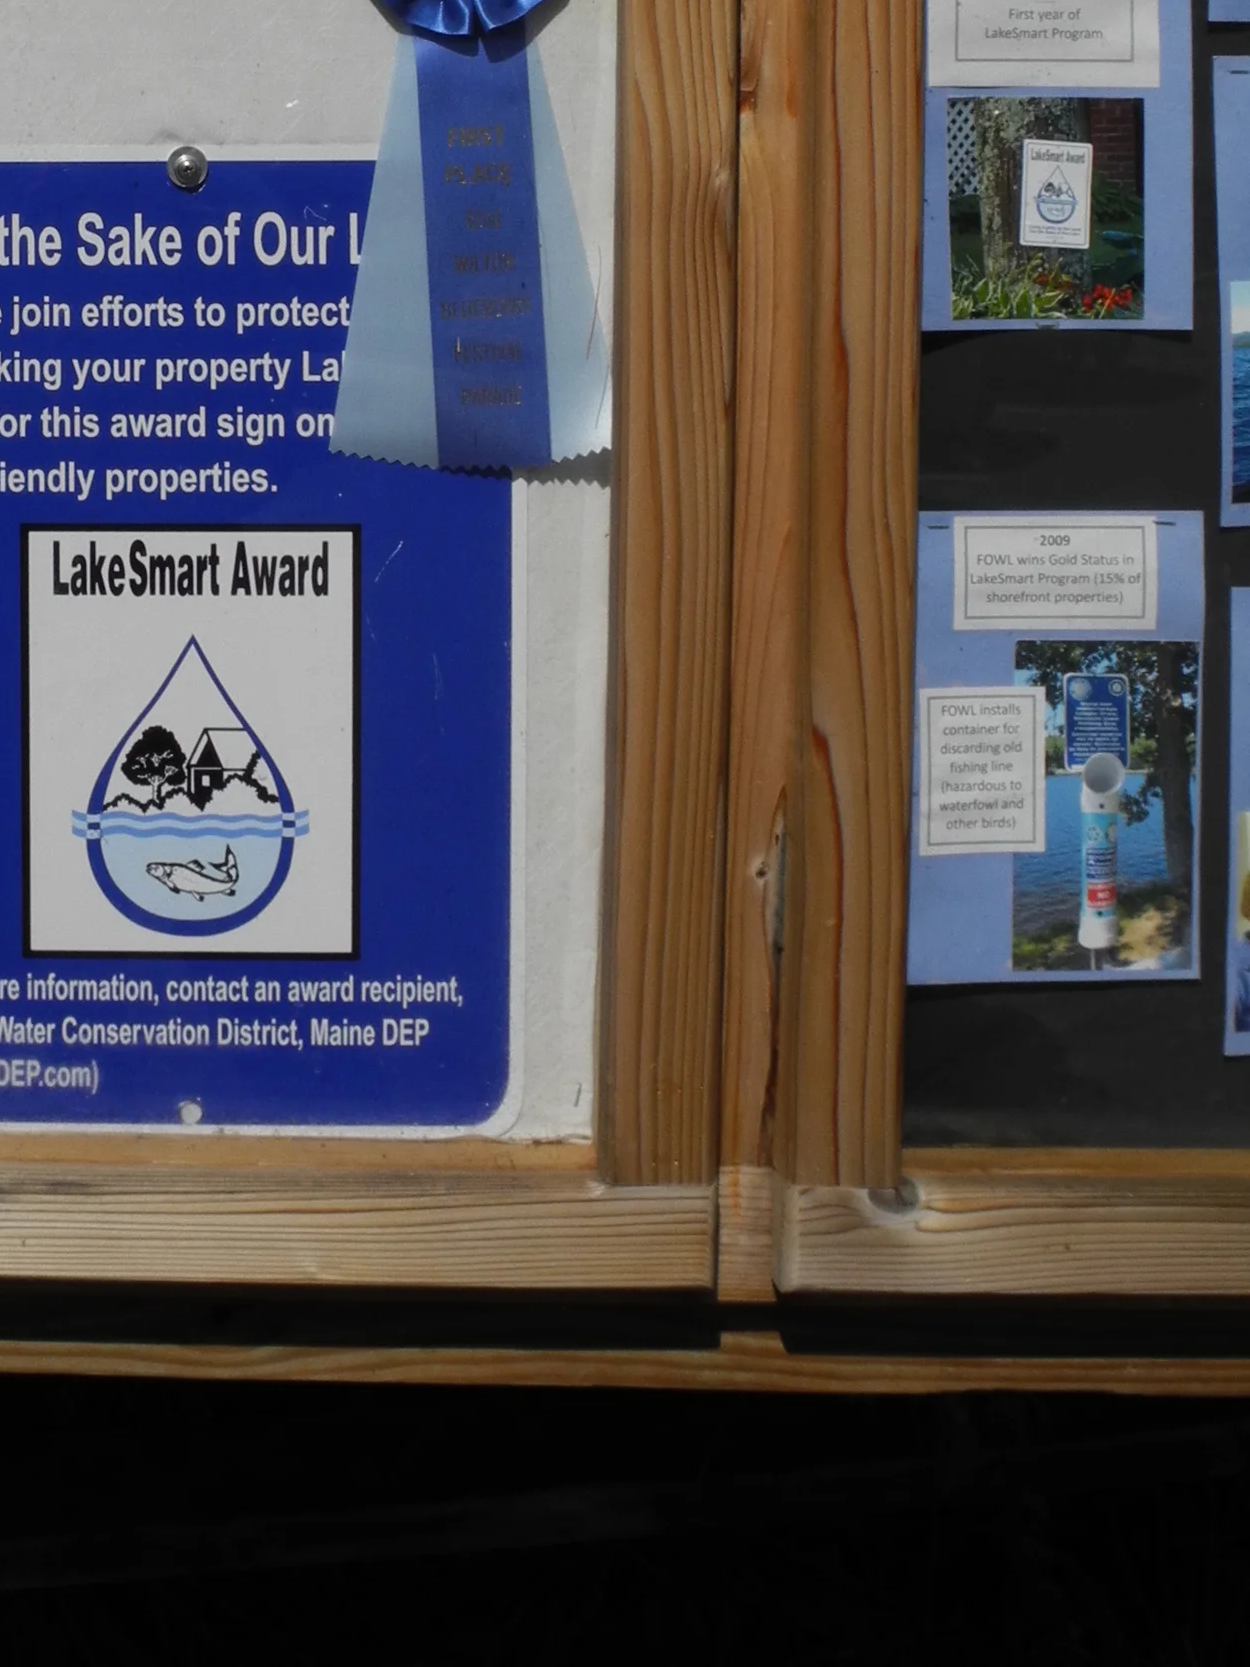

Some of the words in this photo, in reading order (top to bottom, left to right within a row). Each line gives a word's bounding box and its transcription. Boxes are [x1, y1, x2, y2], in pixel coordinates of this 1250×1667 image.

[1009, 8, 1034, 20] First
[1038, 11, 1064, 22] year
[1068, 8, 1081, 20] of
[985, 27, 1047, 39] LakeSmart
[1052, 28, 1103, 41] Program
[78, 213, 182, 266] Sake
[198, 212, 241, 265] of
[254, 212, 335, 265] Our
[10, 296, 70, 335] join
[82, 295, 184, 327] efforts
[194, 297, 225, 326] to
[237, 296, 349, 337] protect
[72, 359, 146, 390] your
[156, 352, 291, 390] property
[303, 351, 347, 382] La
[41, 406, 99, 437] this
[111, 406, 205, 437] award
[217, 406, 284, 445] sign
[295, 414, 334, 438] on
[106, 461, 277, 500] properties.
[1040, 535, 1070, 546] 2009
[53, 540, 219, 597] LakeSmart
[231, 541, 328, 597] Award
[977, 554, 1013, 566] FOWL
[1017, 556, 1045, 565] wins
[1049, 554, 1077, 566] Gold
[1081, 554, 1119, 565] Status
[970, 573, 1034, 584] LakeSmart
[1038, 573, 1090, 587] Program
[1094, 573, 1125, 586] (15%
[1127, 573, 1142, 586] of
[986, 591, 1050, 602] shorefront
[1054, 592, 1123, 604] properties)
[27, 973, 158, 1006] information,
[166, 976, 248, 1002] contact
[255, 981, 280, 1002] an
[288, 975, 353, 1002] award
[362, 975, 462, 1009] recipient,
[62, 1016, 209, 1045] Conservation
[218, 1018, 303, 1050] District,
[311, 1018, 375, 1046] Maine
[383, 1019, 429, 1045] DEP
